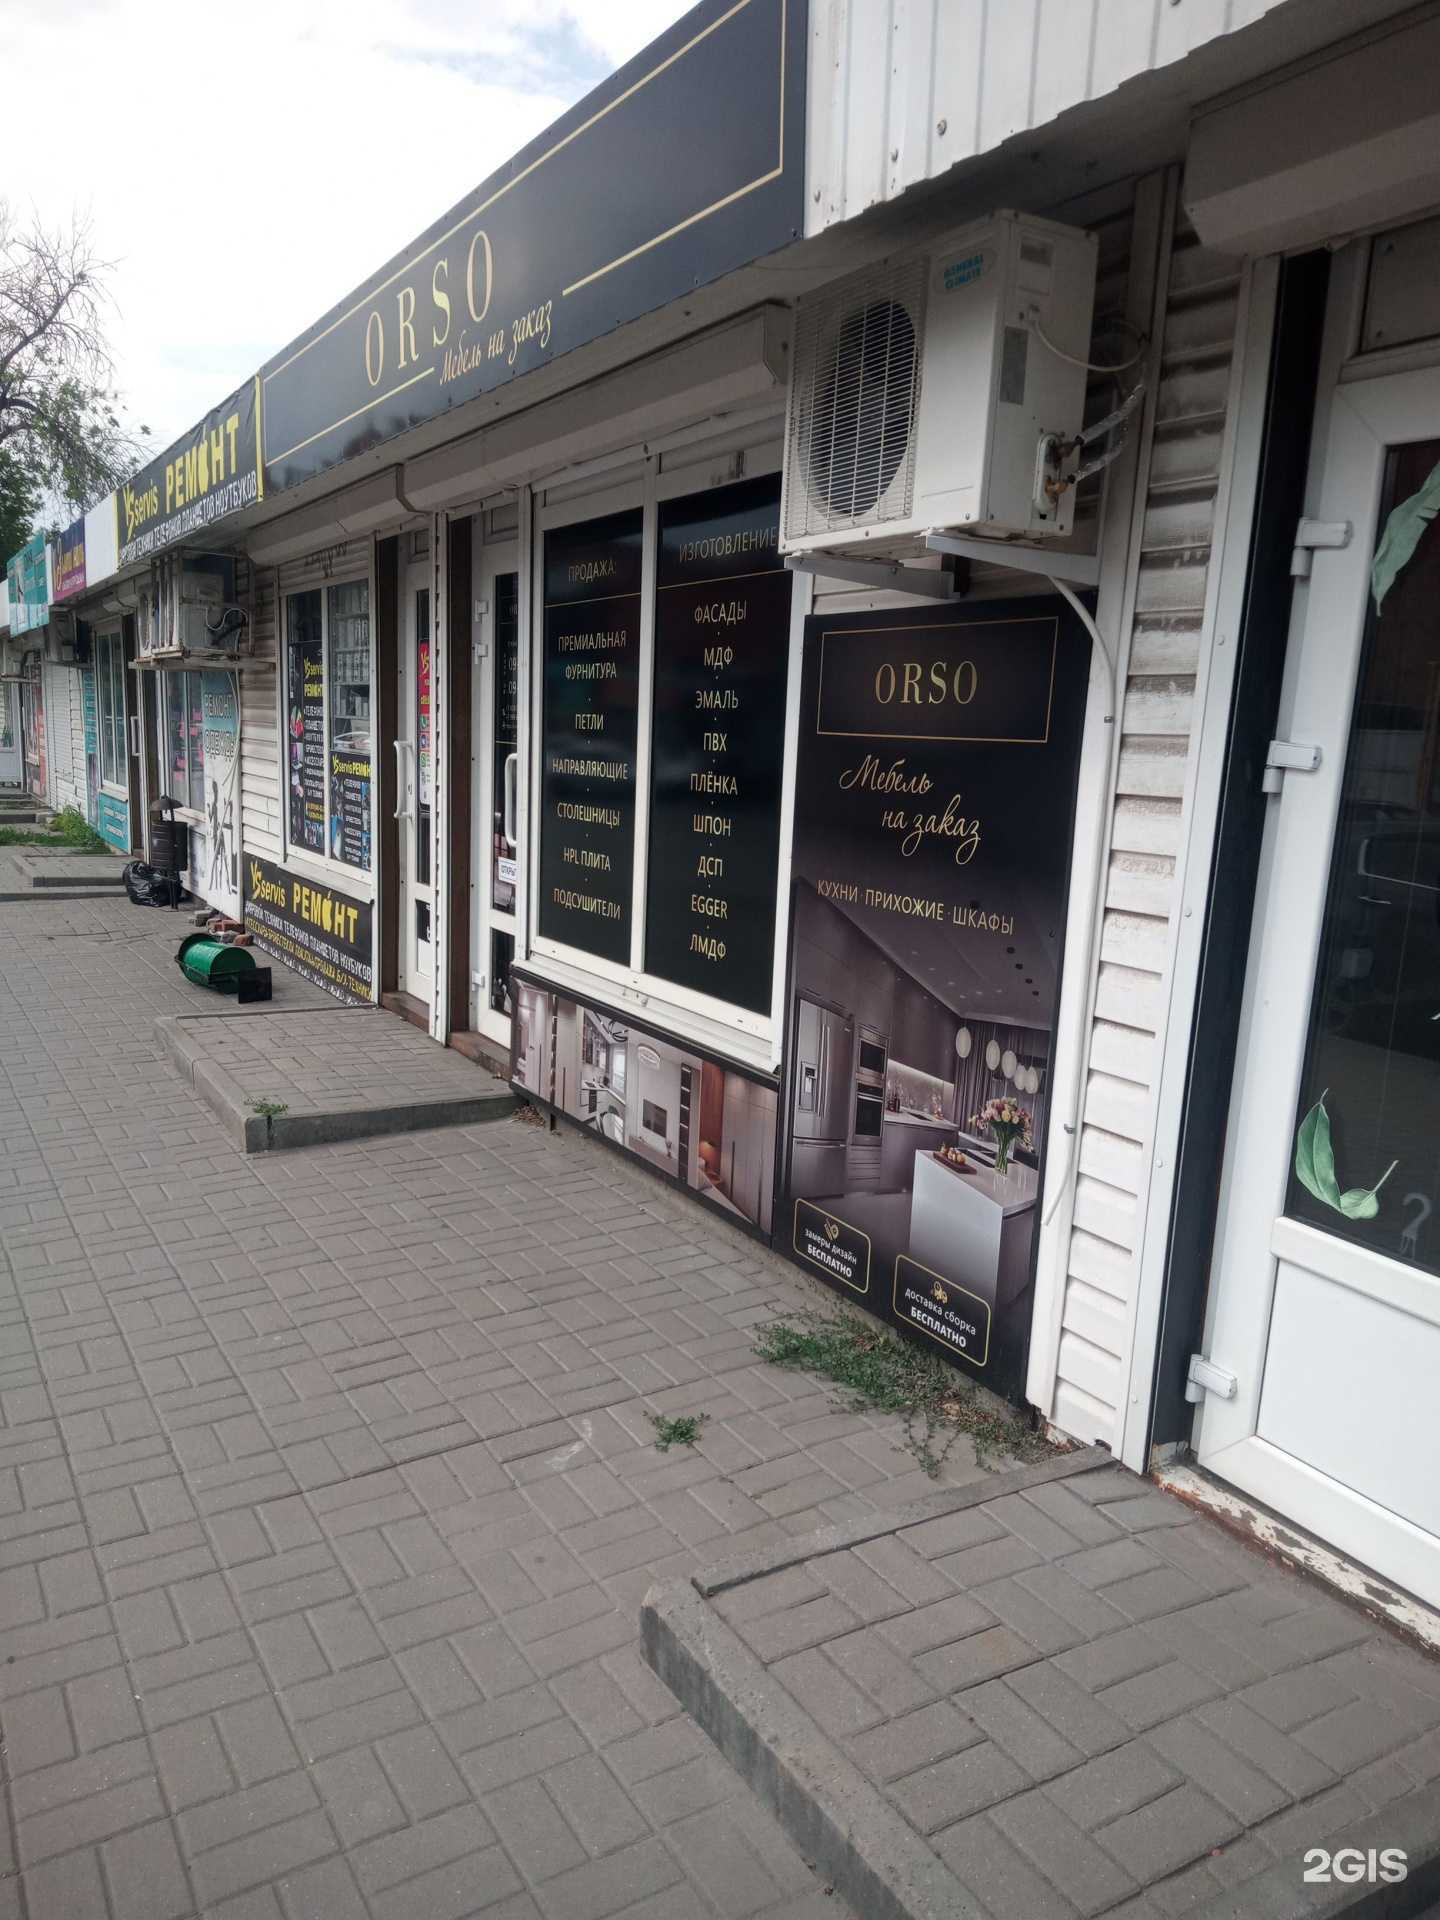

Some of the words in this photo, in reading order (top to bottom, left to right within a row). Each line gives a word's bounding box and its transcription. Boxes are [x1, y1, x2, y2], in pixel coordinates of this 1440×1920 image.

[366, 230, 493, 387] ORSO
[439, 330, 482, 386] Мебель
[487, 329, 505, 360] на
[507, 300, 553, 366] заказ
[215, 470, 257, 516] НОУТБУКОВ
[679, 527, 778, 563] ИЗГОТОВЛЕНИЕ
[568, 557, 617, 583] ПРОДАЖА:
[694, 600, 747, 625] ФАСАДЫ
[558, 630, 626, 652] ПРЕМИАЛЬНАЯ
[565, 662, 617, 680] ФУРНИТУРА
[703, 646, 734, 670] МДФ
[874, 660, 978, 705] ORSO
[695, 690, 739, 710] ЭМАЛЬ
[575, 713, 604, 731] ПЕТЛИ
[703, 732, 727, 752] ПВХ
[552, 758, 629, 780] НАПРАВЛЯЮЩИЕ
[690, 771, 738, 795] ПЛЁНКА
[838, 754, 934, 795] Мебель
[556, 802, 620, 829] СТОЛЕШНИЦЫ
[693, 814, 731, 837] ШПОН
[881, 810, 908, 829] на
[901, 794, 981, 866] заказ
[563, 847, 580, 865] HPL
[581, 850, 611, 871] ПЛИТА
[697, 855, 723, 878] ДСП
[553, 888, 621, 920] ПОДСУШИТЕЛИ
[691, 894, 728, 920] EGGER
[817, 879, 858, 903] КУХНИ
[865, 888, 944, 921] ПРИХОЖИЕ
[952, 906, 1014, 936] ШКАФЫ
[689, 933, 727, 962] ЛМДФ
[340, 952, 372, 982] НОУТБУКОВ
[804, 1228, 831, 1250] замеры
[831, 1243, 857, 1265] дизайн
[807, 1244, 853, 1278] БЕСПЛАТНО
[904, 1287, 943, 1316] доставка
[944, 1309, 977, 1336] сборка
[910, 1306, 967, 1348] БЕСПЛАТНО
